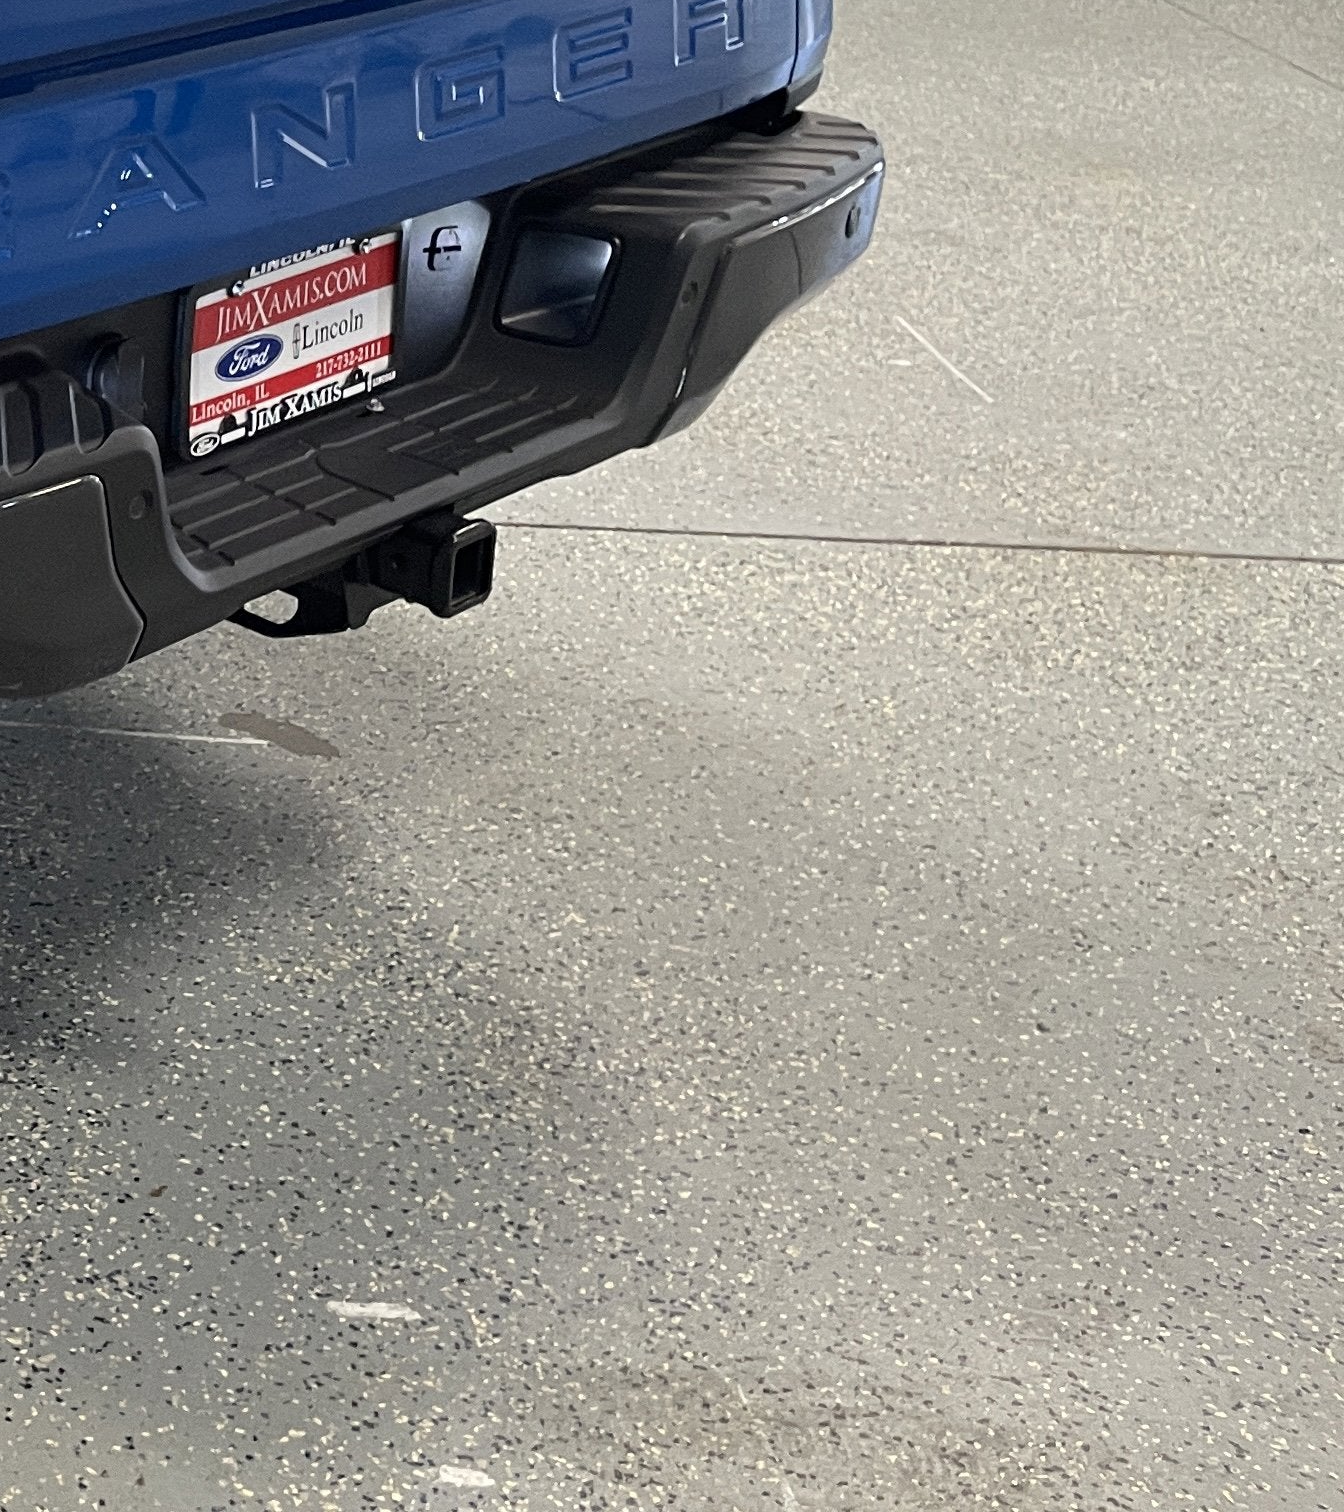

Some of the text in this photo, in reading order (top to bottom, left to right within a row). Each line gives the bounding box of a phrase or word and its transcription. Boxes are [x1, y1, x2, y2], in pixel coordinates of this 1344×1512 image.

[215, 263, 367, 343] JIMXAMIS.COM
[229, 308, 363, 376] Ford Lincoln
[316, 341, 381, 378] 217-732-2111
[192, 384, 270, 423] Lincoln, IL
[248, 386, 342, 437] JIM XAMIS
